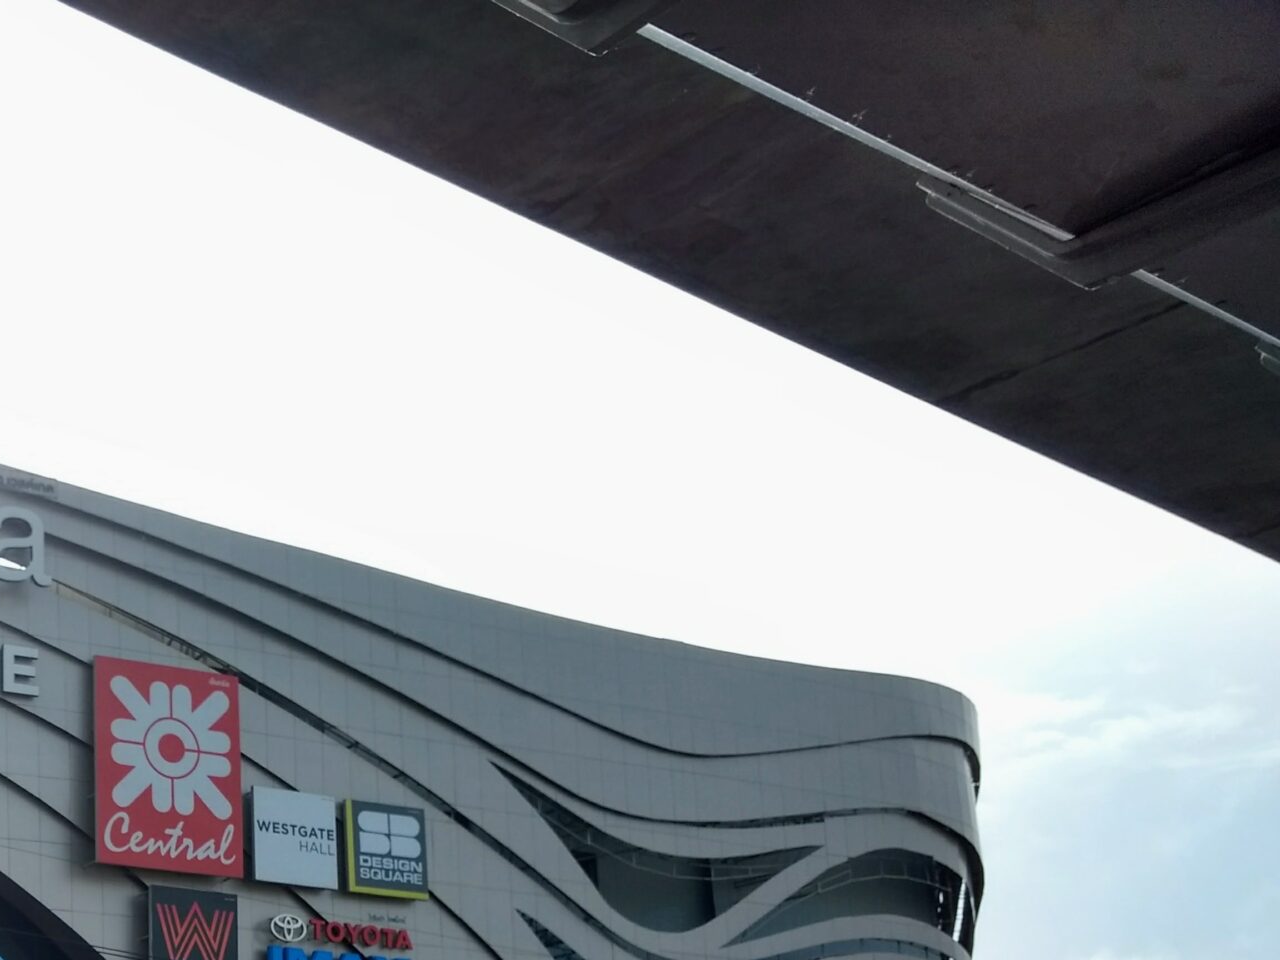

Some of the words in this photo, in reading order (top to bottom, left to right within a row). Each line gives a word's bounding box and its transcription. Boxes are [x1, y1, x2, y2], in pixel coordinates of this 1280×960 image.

[104, 811, 236, 865] Central
[257, 819, 335, 841] WESTGATE
[299, 840, 335, 856] HALL
[359, 855, 423, 872] DESIGN
[359, 867, 423, 885] SQUARE
[309, 917, 413, 949] TOYOTA
